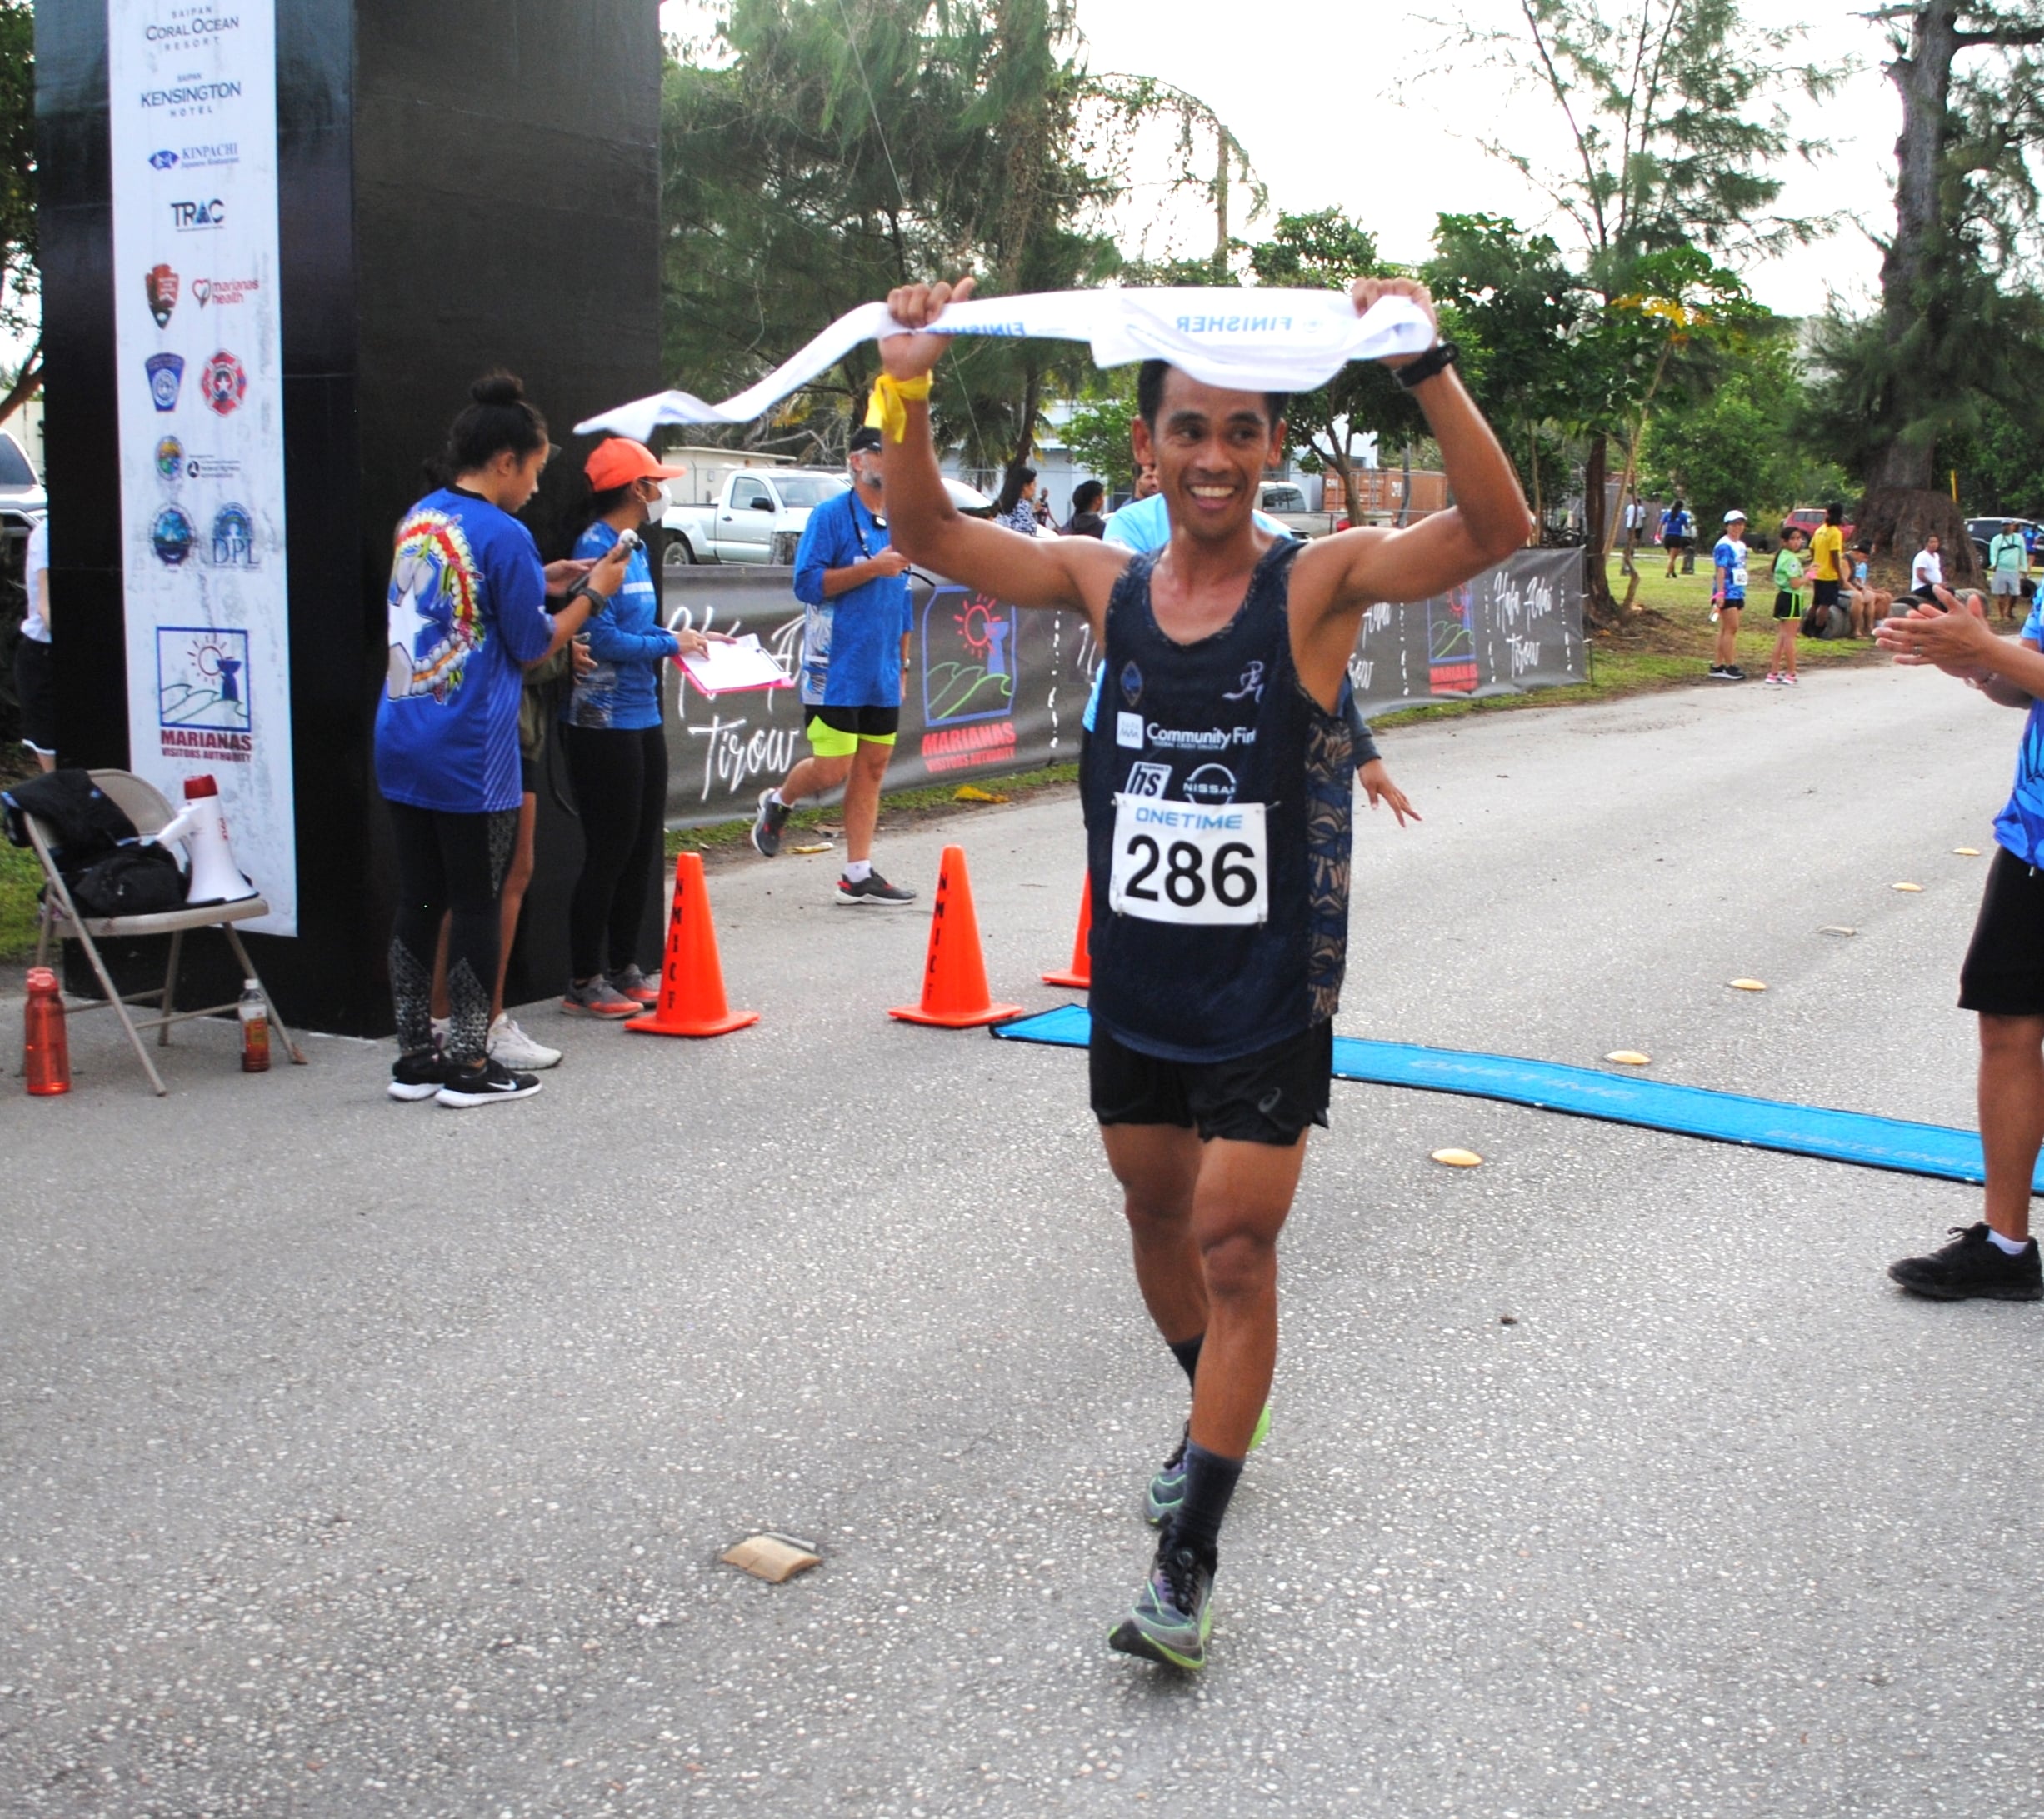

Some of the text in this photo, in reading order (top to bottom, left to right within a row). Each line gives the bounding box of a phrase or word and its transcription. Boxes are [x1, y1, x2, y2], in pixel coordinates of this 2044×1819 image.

[146, 16, 240, 41] CORAL OCEAN
[140, 81, 242, 108] KENSINGTON
[182, 142, 238, 160] KINPACHI
[170, 198, 225, 227] TRAC
[212, 279, 259, 291] marianas
[212, 292, 245, 305] health
[160, 729, 252, 752] MARIANAS
[922, 722, 1017, 757] MARIANAS
[1146, 722, 1232, 750] Community
[1135, 807, 1243, 830] ONETIME
[1124, 834, 1257, 907] 286
